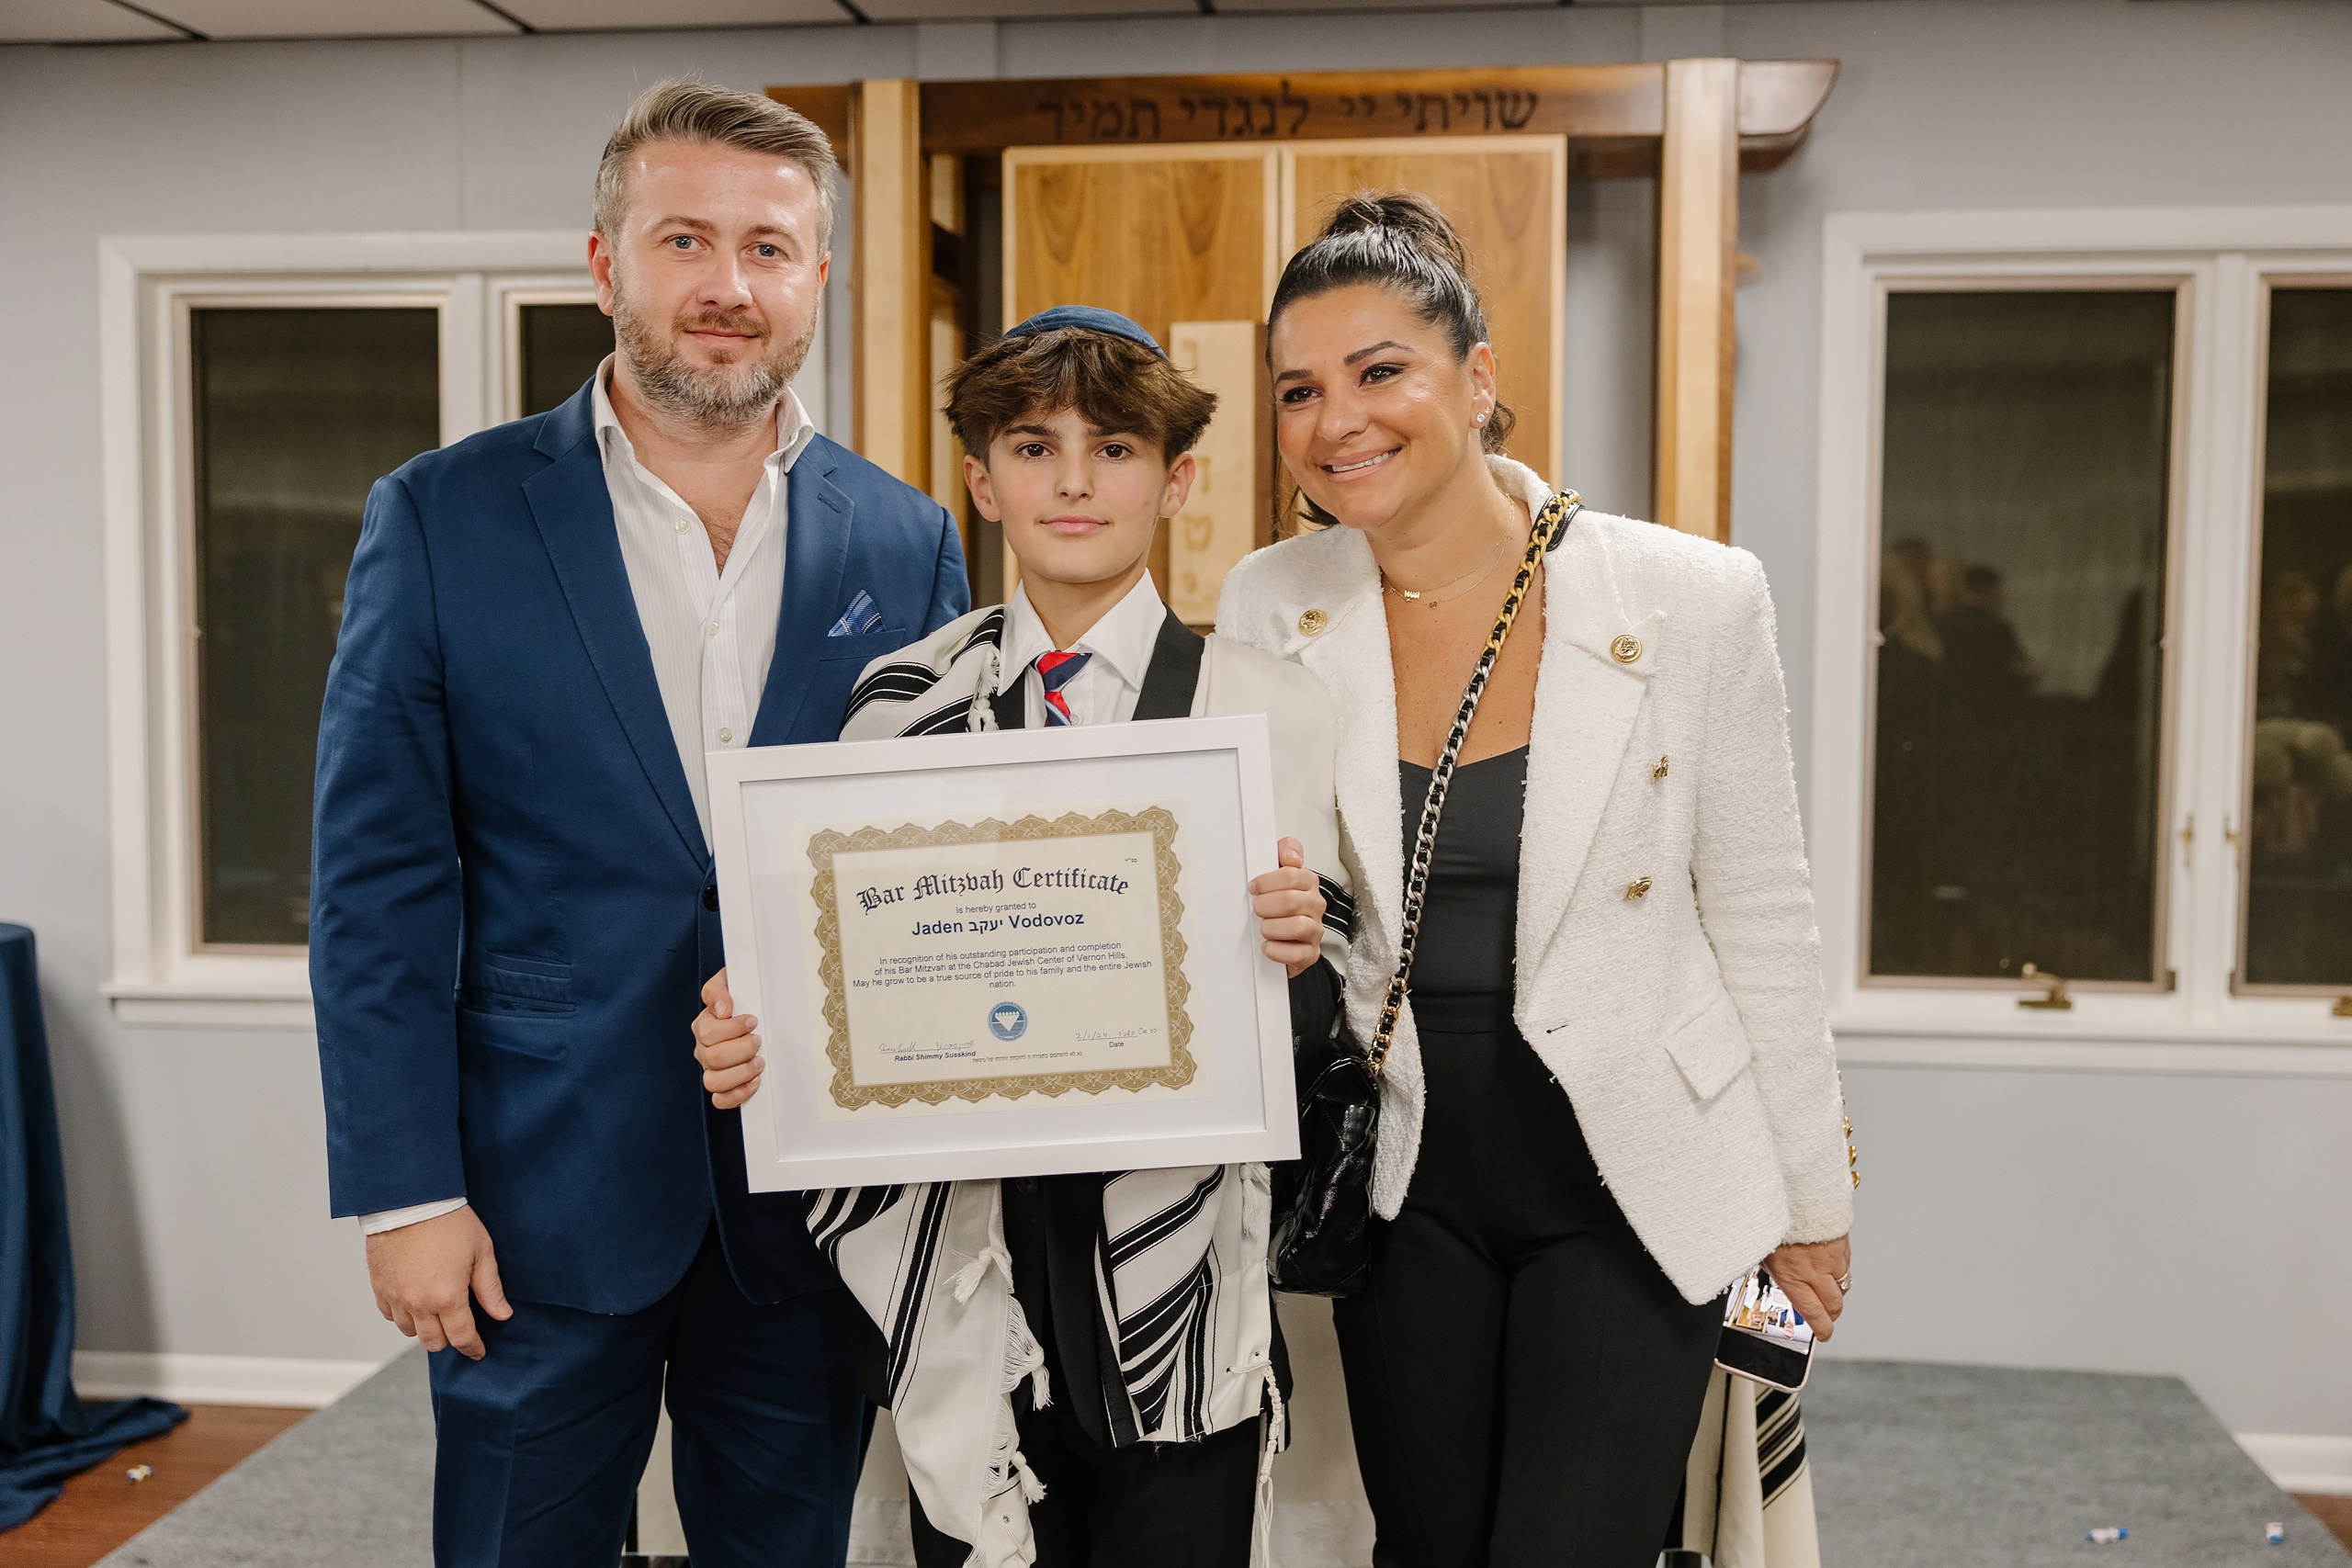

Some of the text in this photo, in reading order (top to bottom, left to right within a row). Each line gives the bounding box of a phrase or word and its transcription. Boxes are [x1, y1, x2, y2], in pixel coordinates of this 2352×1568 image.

[1034, 78, 1540, 141] שויתי יי לנגדי תמיד
[856, 867, 1129, 916] Bar Mitzvah Certificate
[966, 905, 993, 914] hereby
[995, 902, 1026, 913] granted
[911, 914, 1085, 936] Jaden יעקב Vodovoz
[889, 954, 934, 965] recognition
[946, 953, 957, 961] his
[960, 950, 1006, 960] outstanding
[1009, 947, 1057, 957] participation
[1060, 944, 1075, 953] and
[1077, 942, 1122, 952] completion
[915, 964, 946, 973] Mitzvah
[974, 960, 1005, 969] Chabad
[1007, 958, 1035, 967] Jewish
[1037, 956, 1064, 964] Center
[1076, 953, 1106, 962] Vernon
[853, 979, 870, 988] May
[885, 978, 905, 987] grow
[994, 969, 1014, 979] pride
[1040, 966, 1063, 975] family
[1124, 960, 1152, 969] Jewish
[944, 1050, 976, 1059] Susskind
